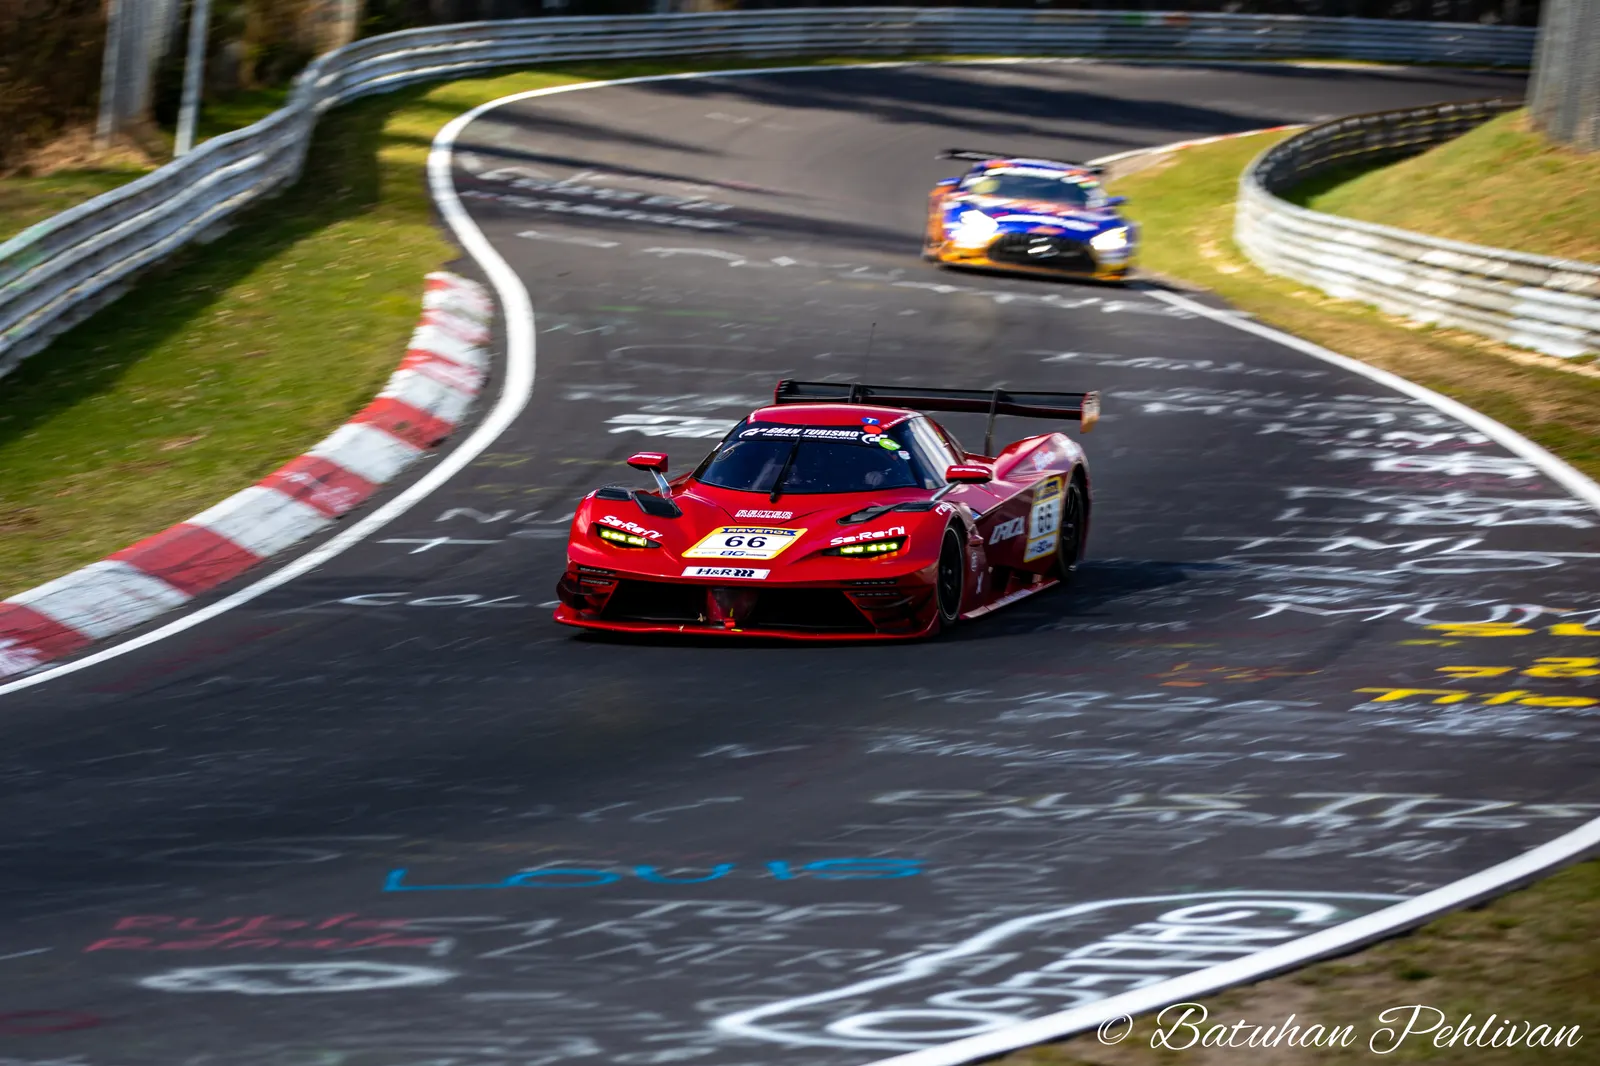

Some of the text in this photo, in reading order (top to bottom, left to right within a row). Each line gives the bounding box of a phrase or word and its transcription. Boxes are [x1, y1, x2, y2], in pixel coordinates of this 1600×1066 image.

[766, 427, 802, 435] GRAN
[803, 428, 859, 437] TURISMO
[727, 528, 792, 536] RAVENOL
[724, 535, 768, 548] 66
[696, 568, 733, 576] H&R
[383, 858, 926, 892] LOUIS
